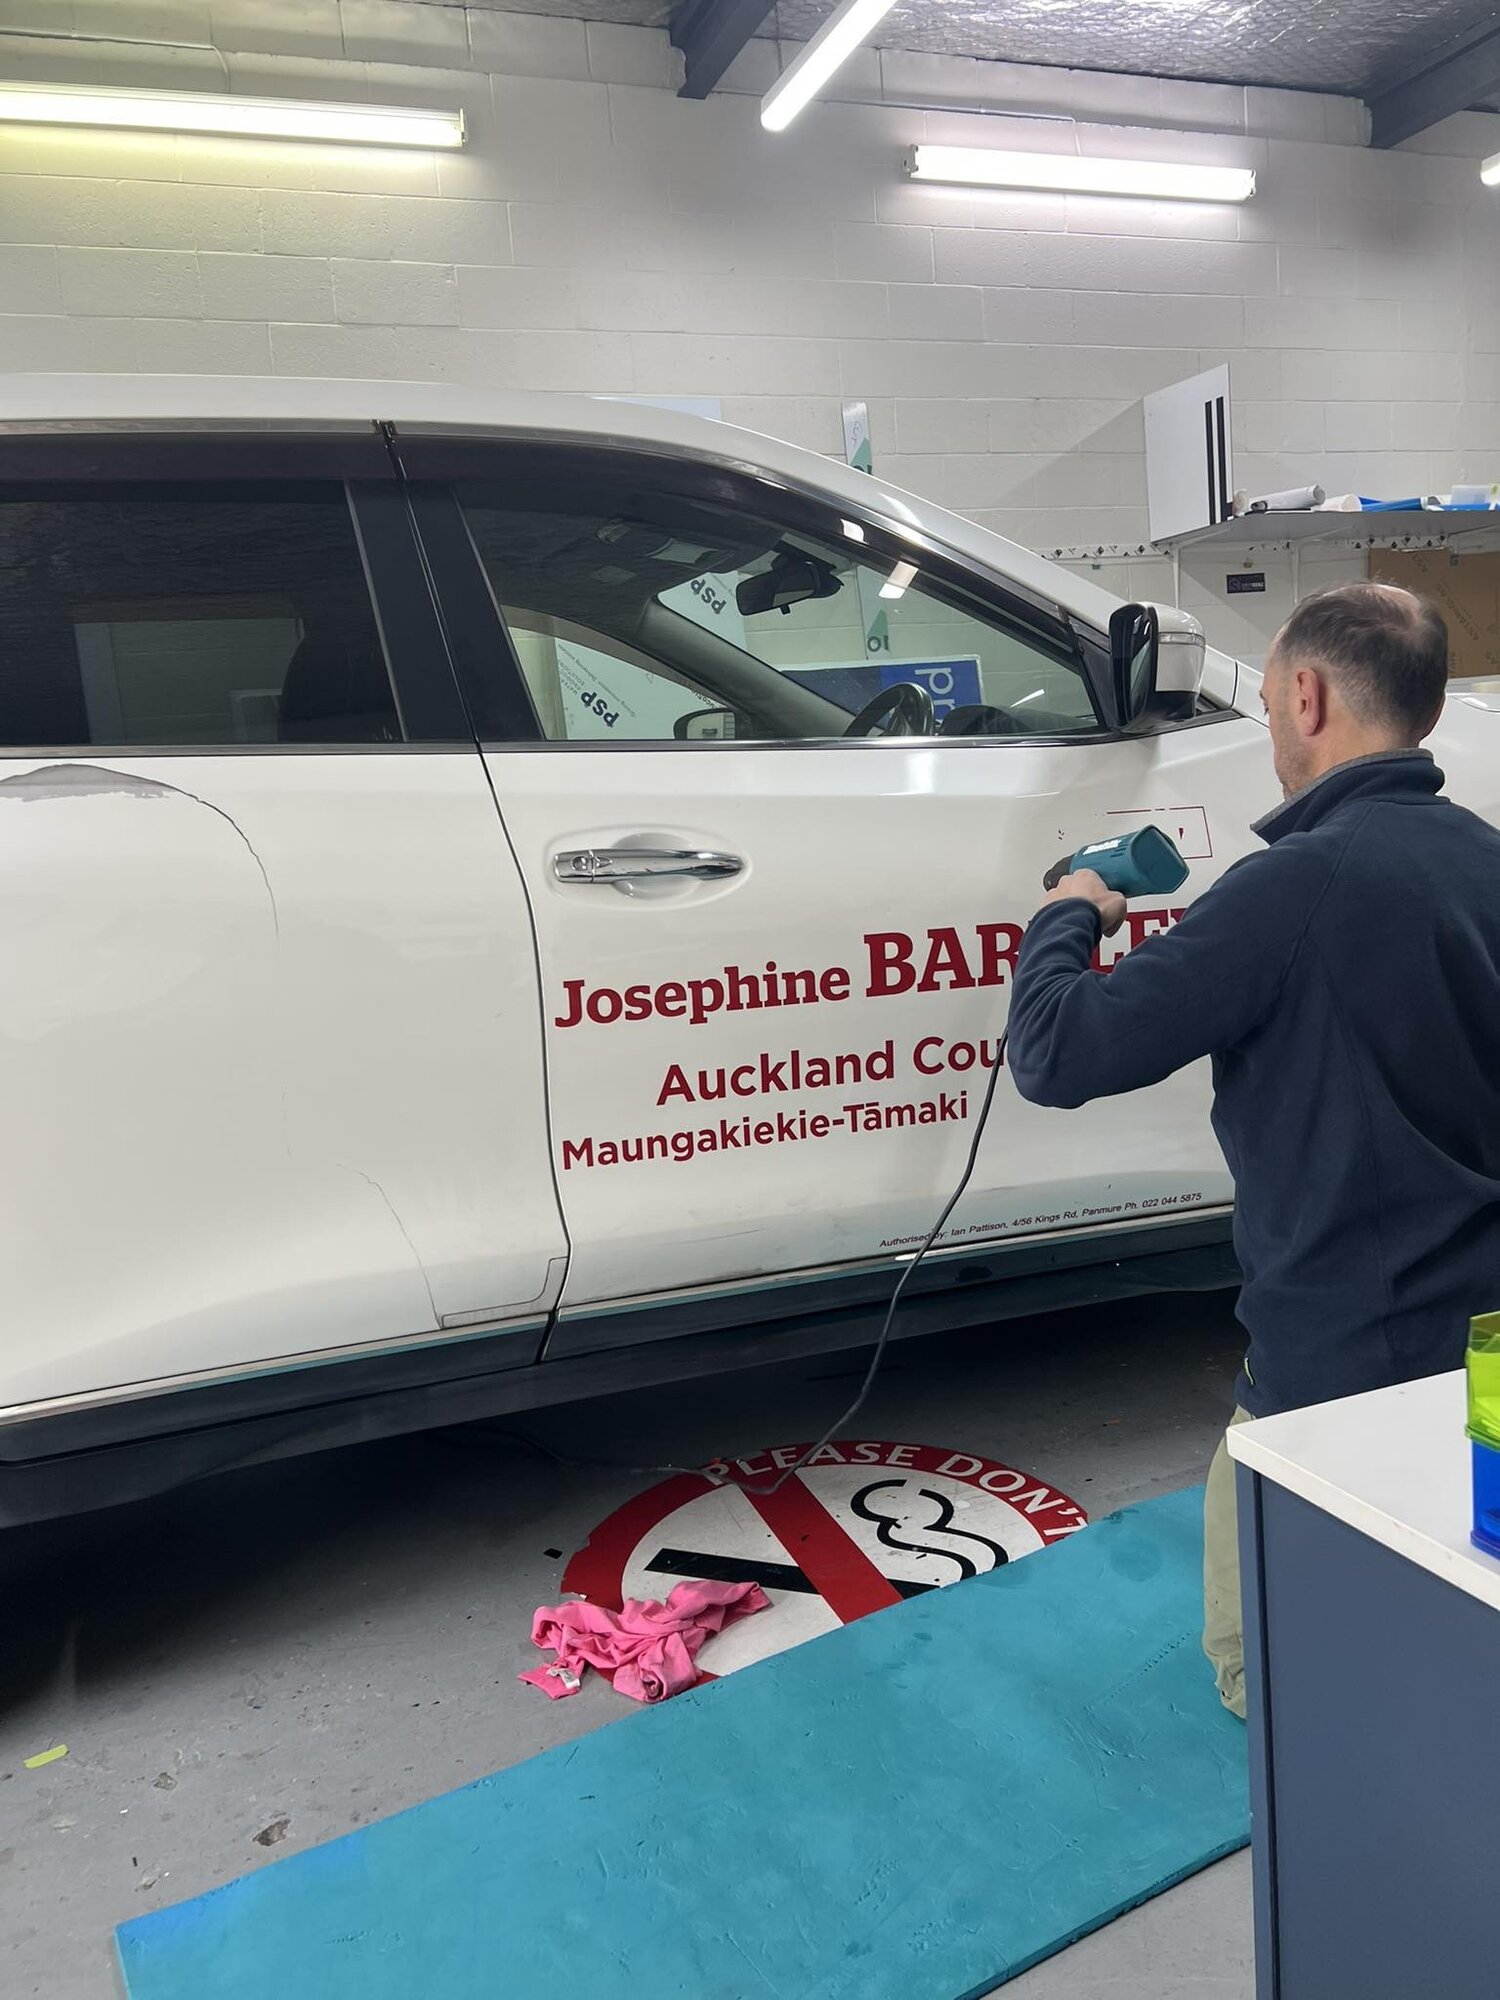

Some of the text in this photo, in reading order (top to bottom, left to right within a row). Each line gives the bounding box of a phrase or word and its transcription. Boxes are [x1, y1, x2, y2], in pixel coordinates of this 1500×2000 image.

[690, 579, 727, 614] PSP
[581, 692, 620, 728] PSP
[555, 961, 851, 1028] Josephine
[656, 1036, 1004, 1106] Auckland Cou
[562, 1091, 968, 1170] Maungakiekie-Tāmaki
[879, 1231, 933, 1247] Authorised
[934, 1229, 948, 1241] by:
[951, 1226, 966, 1236] Ian
[969, 1219, 1008, 1234] Pattison,
[1011, 1215, 1032, 1227] 4/56
[1035, 1211, 1060, 1226] Kings
[1082, 1203, 1122, 1217] Panmure
[1124, 1200, 1139, 1211] Ph.
[1141, 1197, 1159, 1208] 022
[1161, 1194, 1178, 1206] 044
[1180, 1191, 1202, 1204] 5875
[701, 1443, 922, 1486] PLEASE
